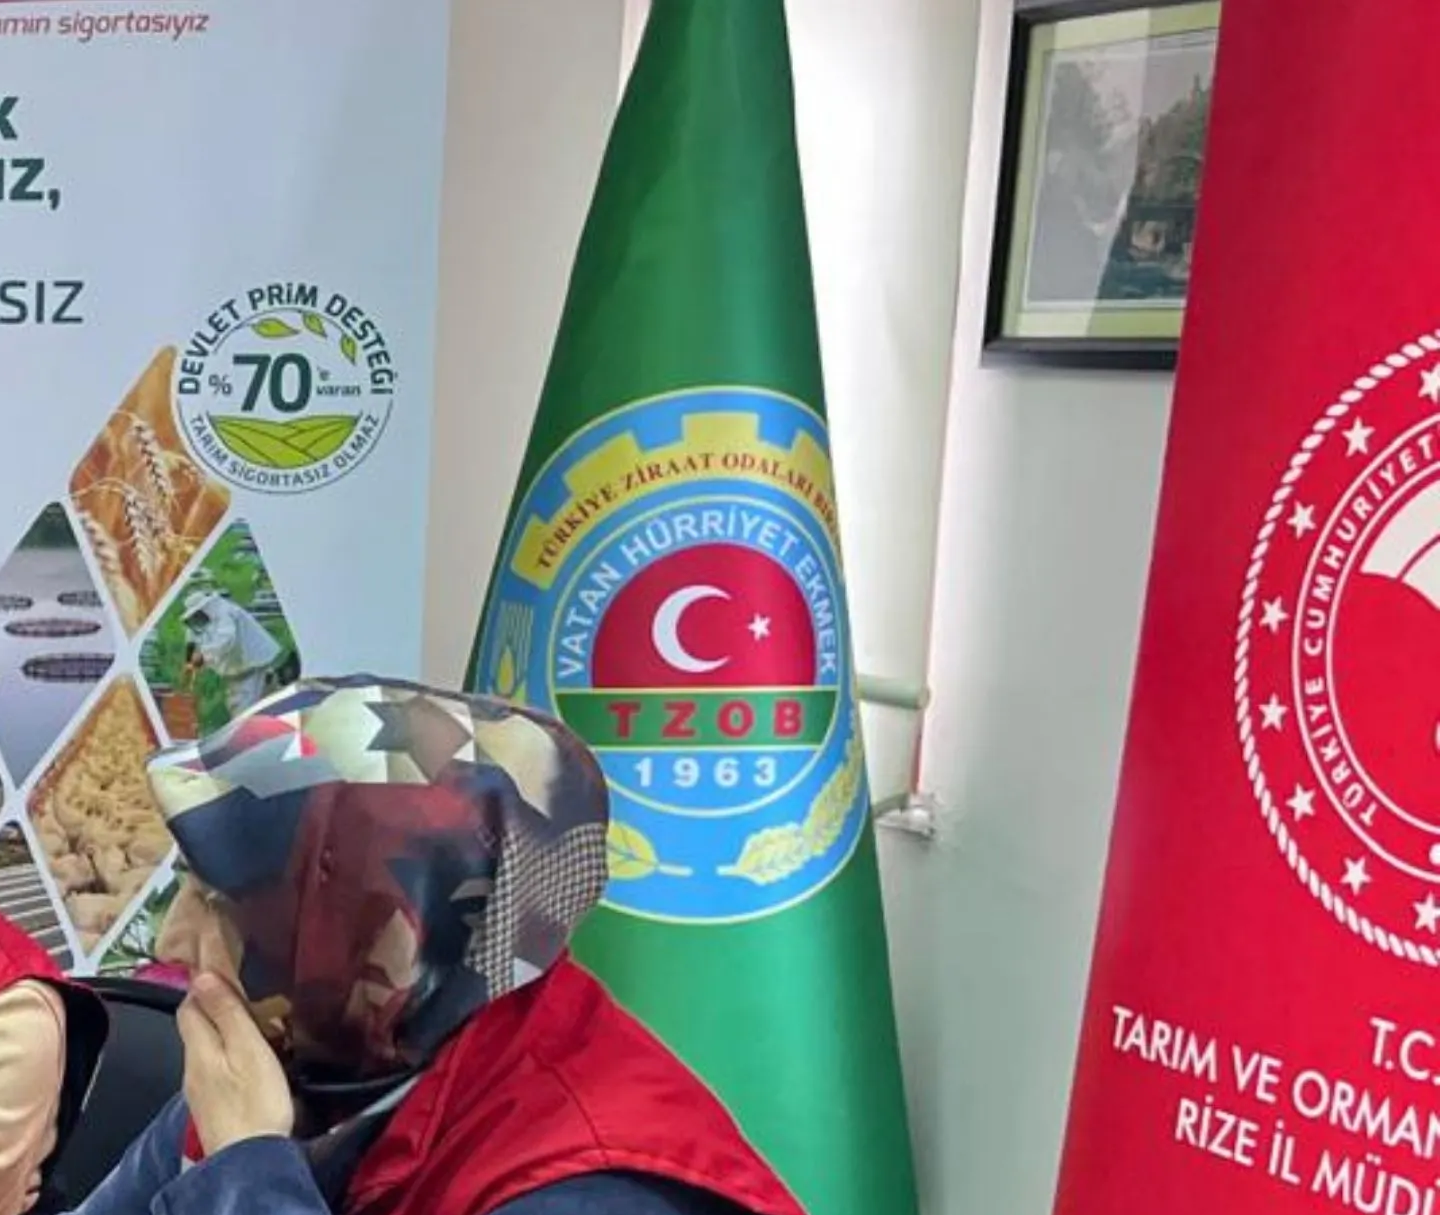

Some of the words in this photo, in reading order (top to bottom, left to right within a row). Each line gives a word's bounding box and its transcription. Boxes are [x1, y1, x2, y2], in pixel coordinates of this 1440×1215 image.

[58, 10, 210, 43] sigortasıyız
[178, 298, 241, 395] DEVLET
[247, 282, 318, 311] PRİM
[316, 384, 361, 397] varan
[189, 413, 229, 468] TARIM
[334, 413, 381, 469] OLMAZ
[533, 483, 618, 569] TÜRKİYE
[620, 452, 714, 492] ZİRAAT
[721, 452, 814, 498] ODALARI
[557, 561, 623, 679] VATAN
[619, 504, 801, 566] HÜRRİYET
[793, 553, 837, 676] EKMEK
[606, 698, 805, 740] TZOB
[633, 756, 777, 789] 1963
[1112, 1004, 1218, 1084] TARIM
[1231, 1043, 1283, 1104] VE
[1370, 1016, 1440, 1086] T.C.
[1175, 1093, 1260, 1167] RİZE
[1267, 1118, 1300, 1185] İL
